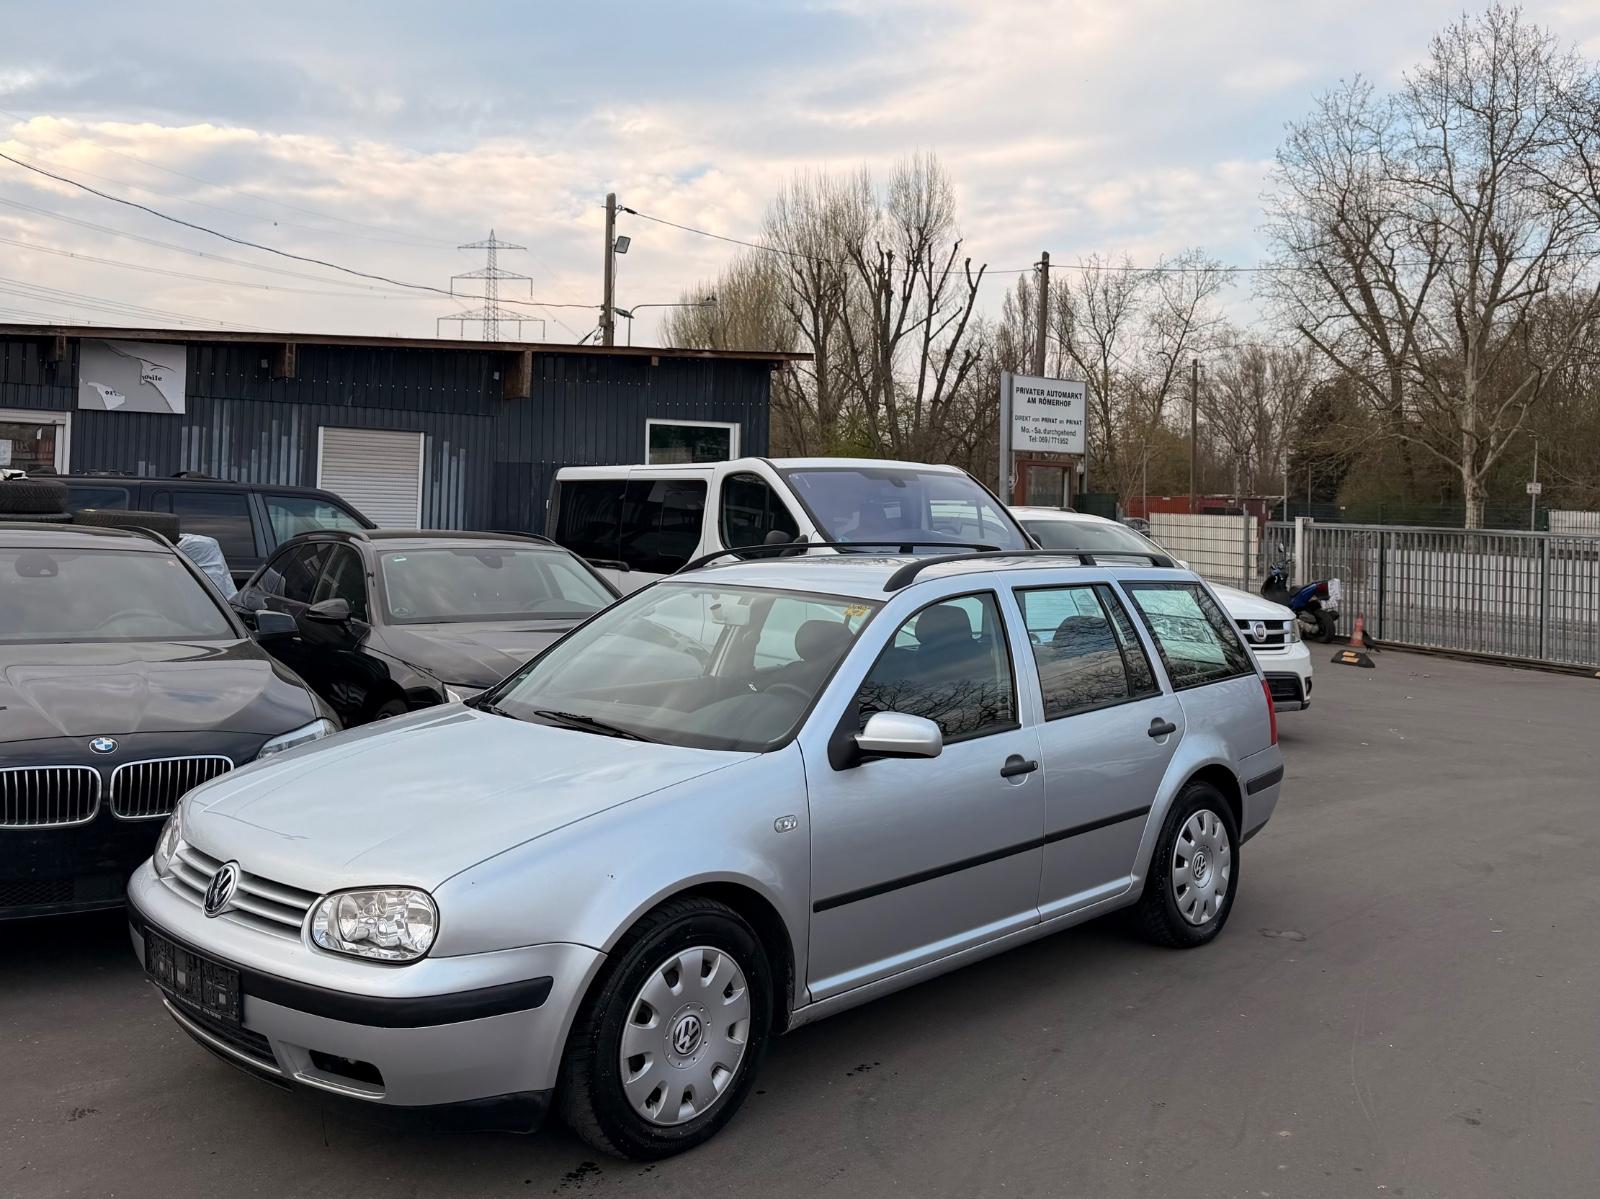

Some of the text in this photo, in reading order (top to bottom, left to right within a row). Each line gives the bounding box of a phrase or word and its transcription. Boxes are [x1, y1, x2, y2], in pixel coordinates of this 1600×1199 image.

[1016, 387, 1082, 400] PRIVATER AUTOMARKT
[1039, 397, 1071, 407] RÖMERHOF
[1043, 428, 1076, 437] durchgehend
